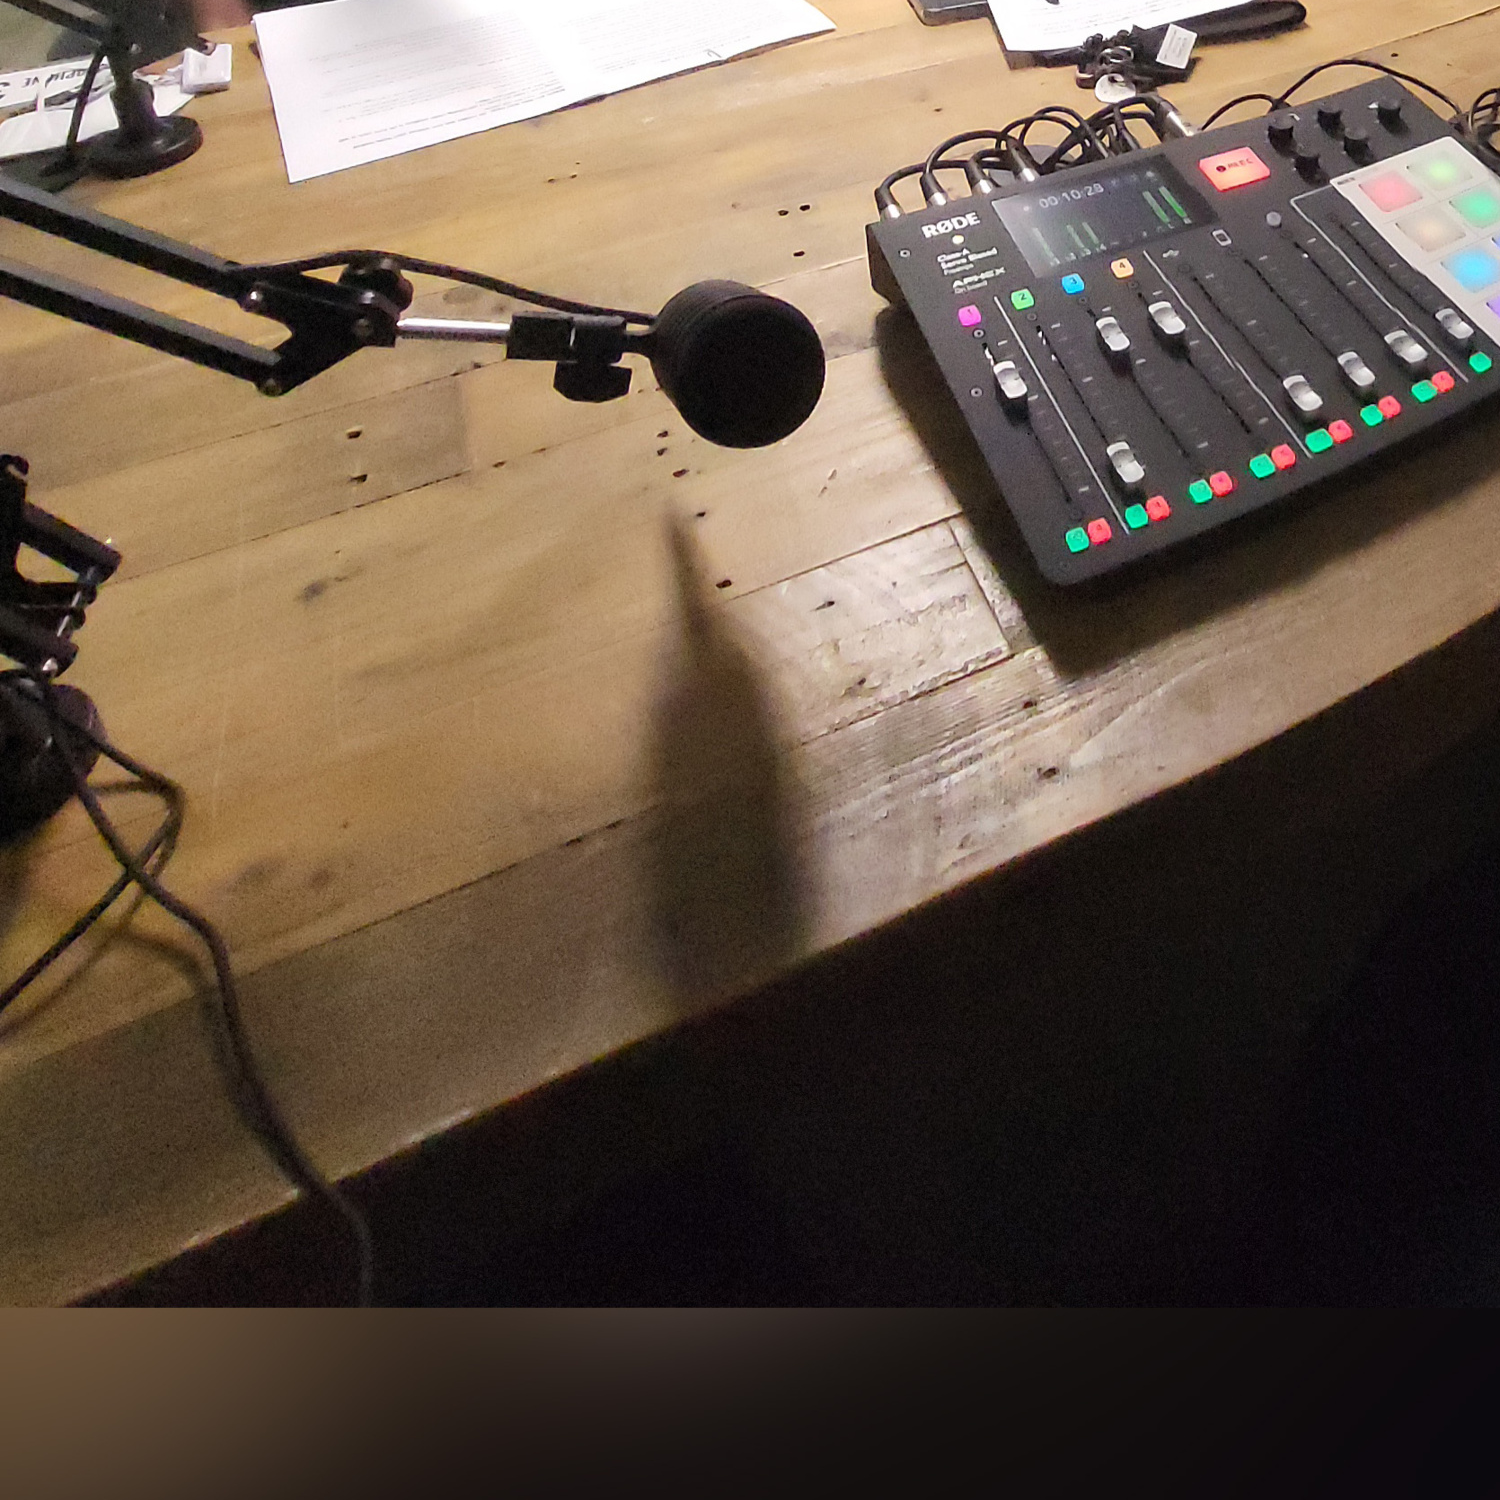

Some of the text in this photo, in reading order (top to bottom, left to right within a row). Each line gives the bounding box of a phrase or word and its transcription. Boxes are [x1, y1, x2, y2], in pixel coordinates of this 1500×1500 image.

[921, 211, 981, 238] RØDE
[1118, 261, 1127, 269] 4
[1069, 277, 1078, 285] 3
[1018, 292, 1027, 301] 2
